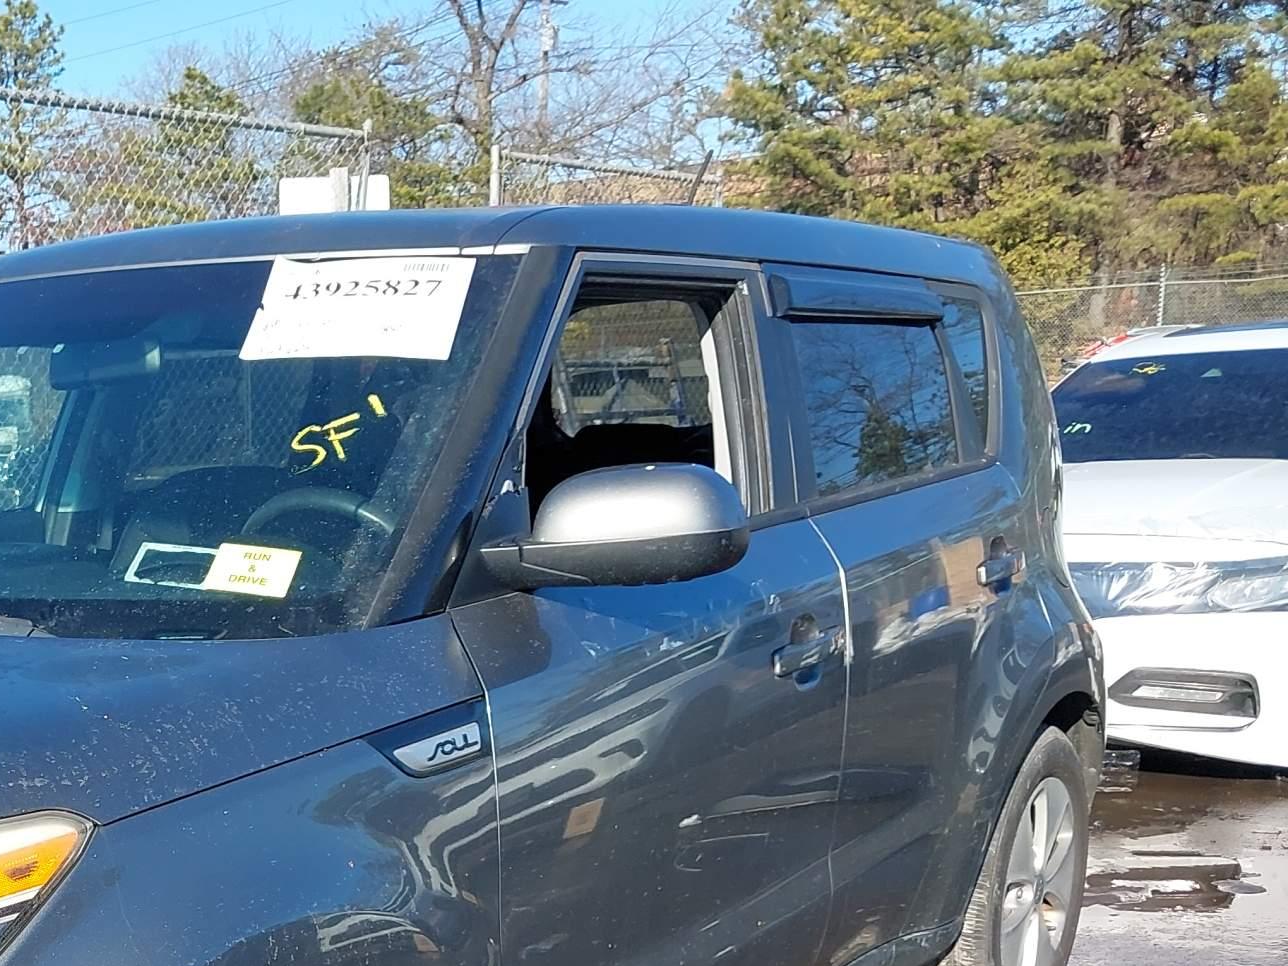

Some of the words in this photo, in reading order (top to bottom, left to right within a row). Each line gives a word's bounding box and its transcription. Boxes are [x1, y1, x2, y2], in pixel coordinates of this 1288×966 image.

[284, 279, 443, 300] 43925827
[243, 552, 272, 562] RUN
[248, 564, 257, 573] &
[228, 574, 270, 586] DRIVE
